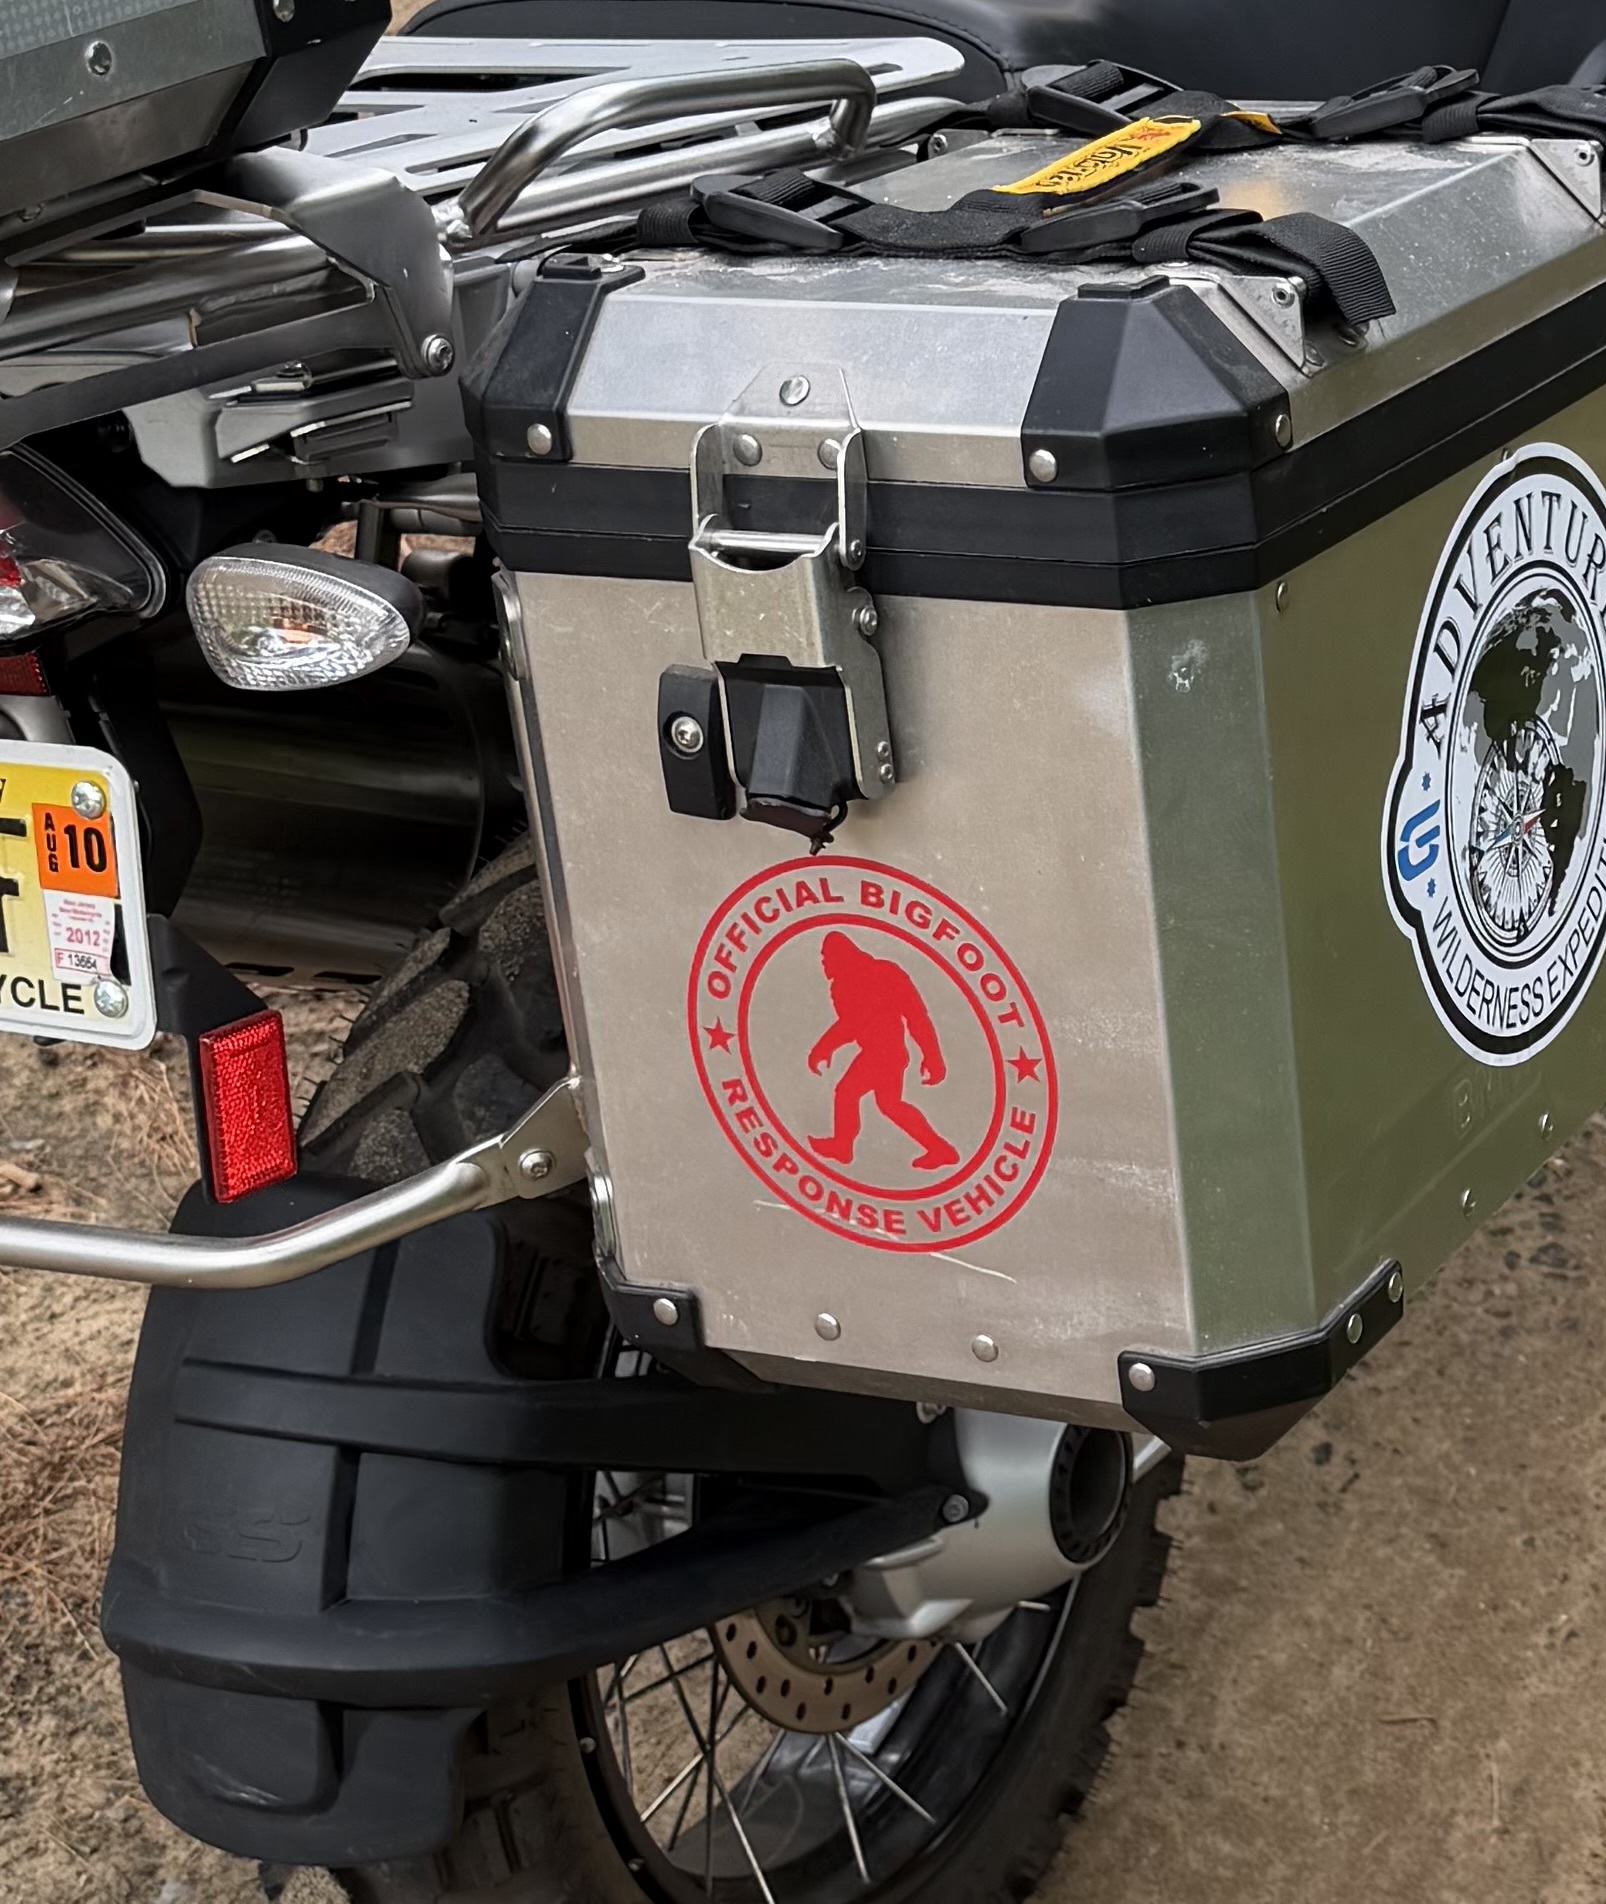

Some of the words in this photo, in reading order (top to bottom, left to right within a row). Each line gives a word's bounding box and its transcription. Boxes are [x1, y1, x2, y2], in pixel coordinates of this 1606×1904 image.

[44, 812, 59, 874] AUG
[64, 823, 107, 873] 10
[66, 927, 101, 947] 2012
[706, 877, 844, 1000] OFFICIAL
[859, 879, 1026, 1030] BIGFOOT
[1431, 895, 1545, 1031] WILDERNESS
[0, 972, 85, 1015] CLE
[721, 1078, 908, 1236] RESPONSE
[916, 1106, 1037, 1234] VEHICLE
